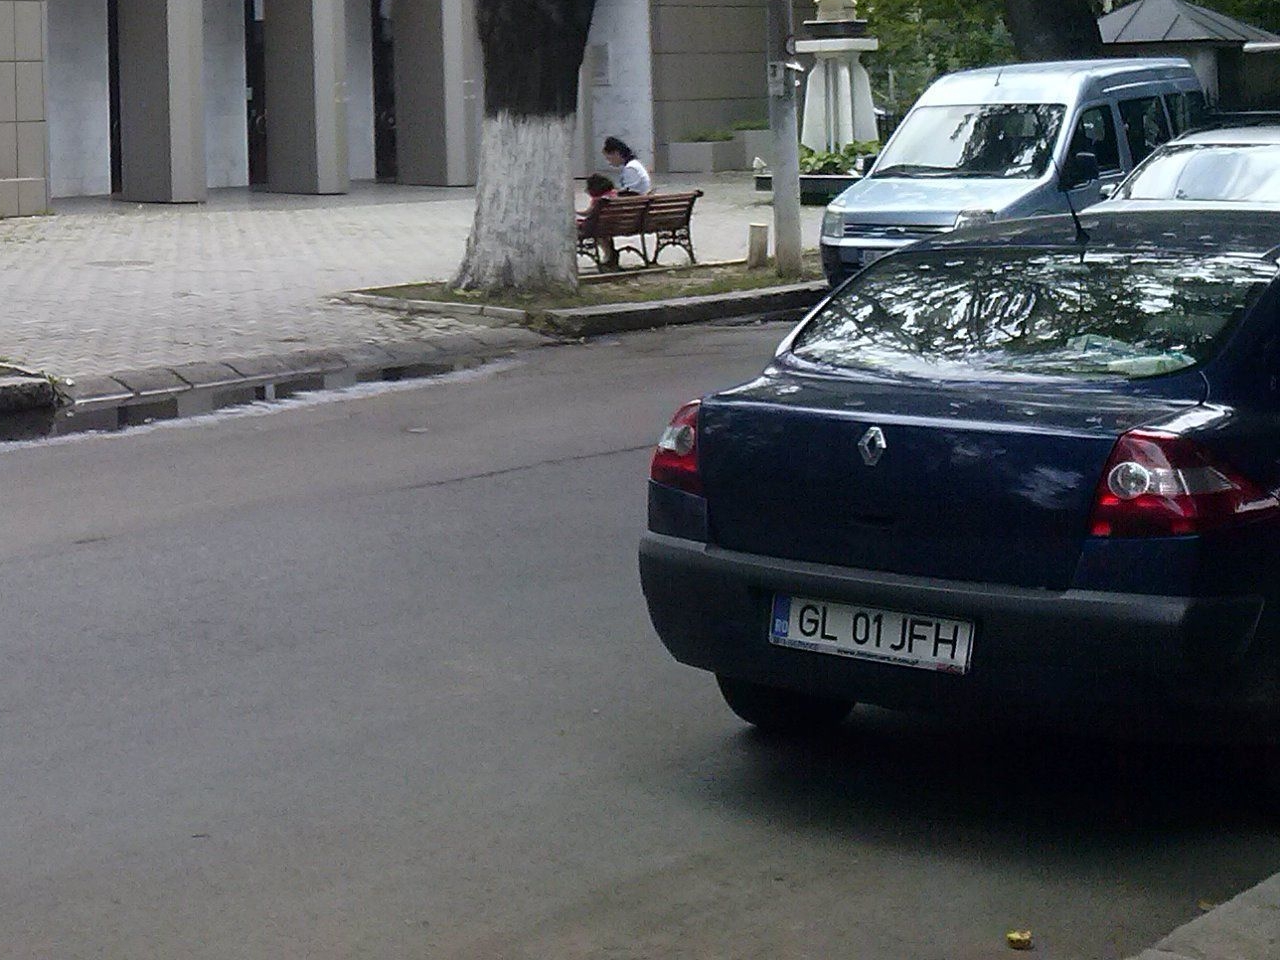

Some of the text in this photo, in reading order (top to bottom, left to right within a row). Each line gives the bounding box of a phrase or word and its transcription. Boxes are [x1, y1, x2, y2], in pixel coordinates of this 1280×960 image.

[799, 605, 837, 641] GL
[853, 612, 882, 647] 01
[890, 618, 958, 659] JFH
